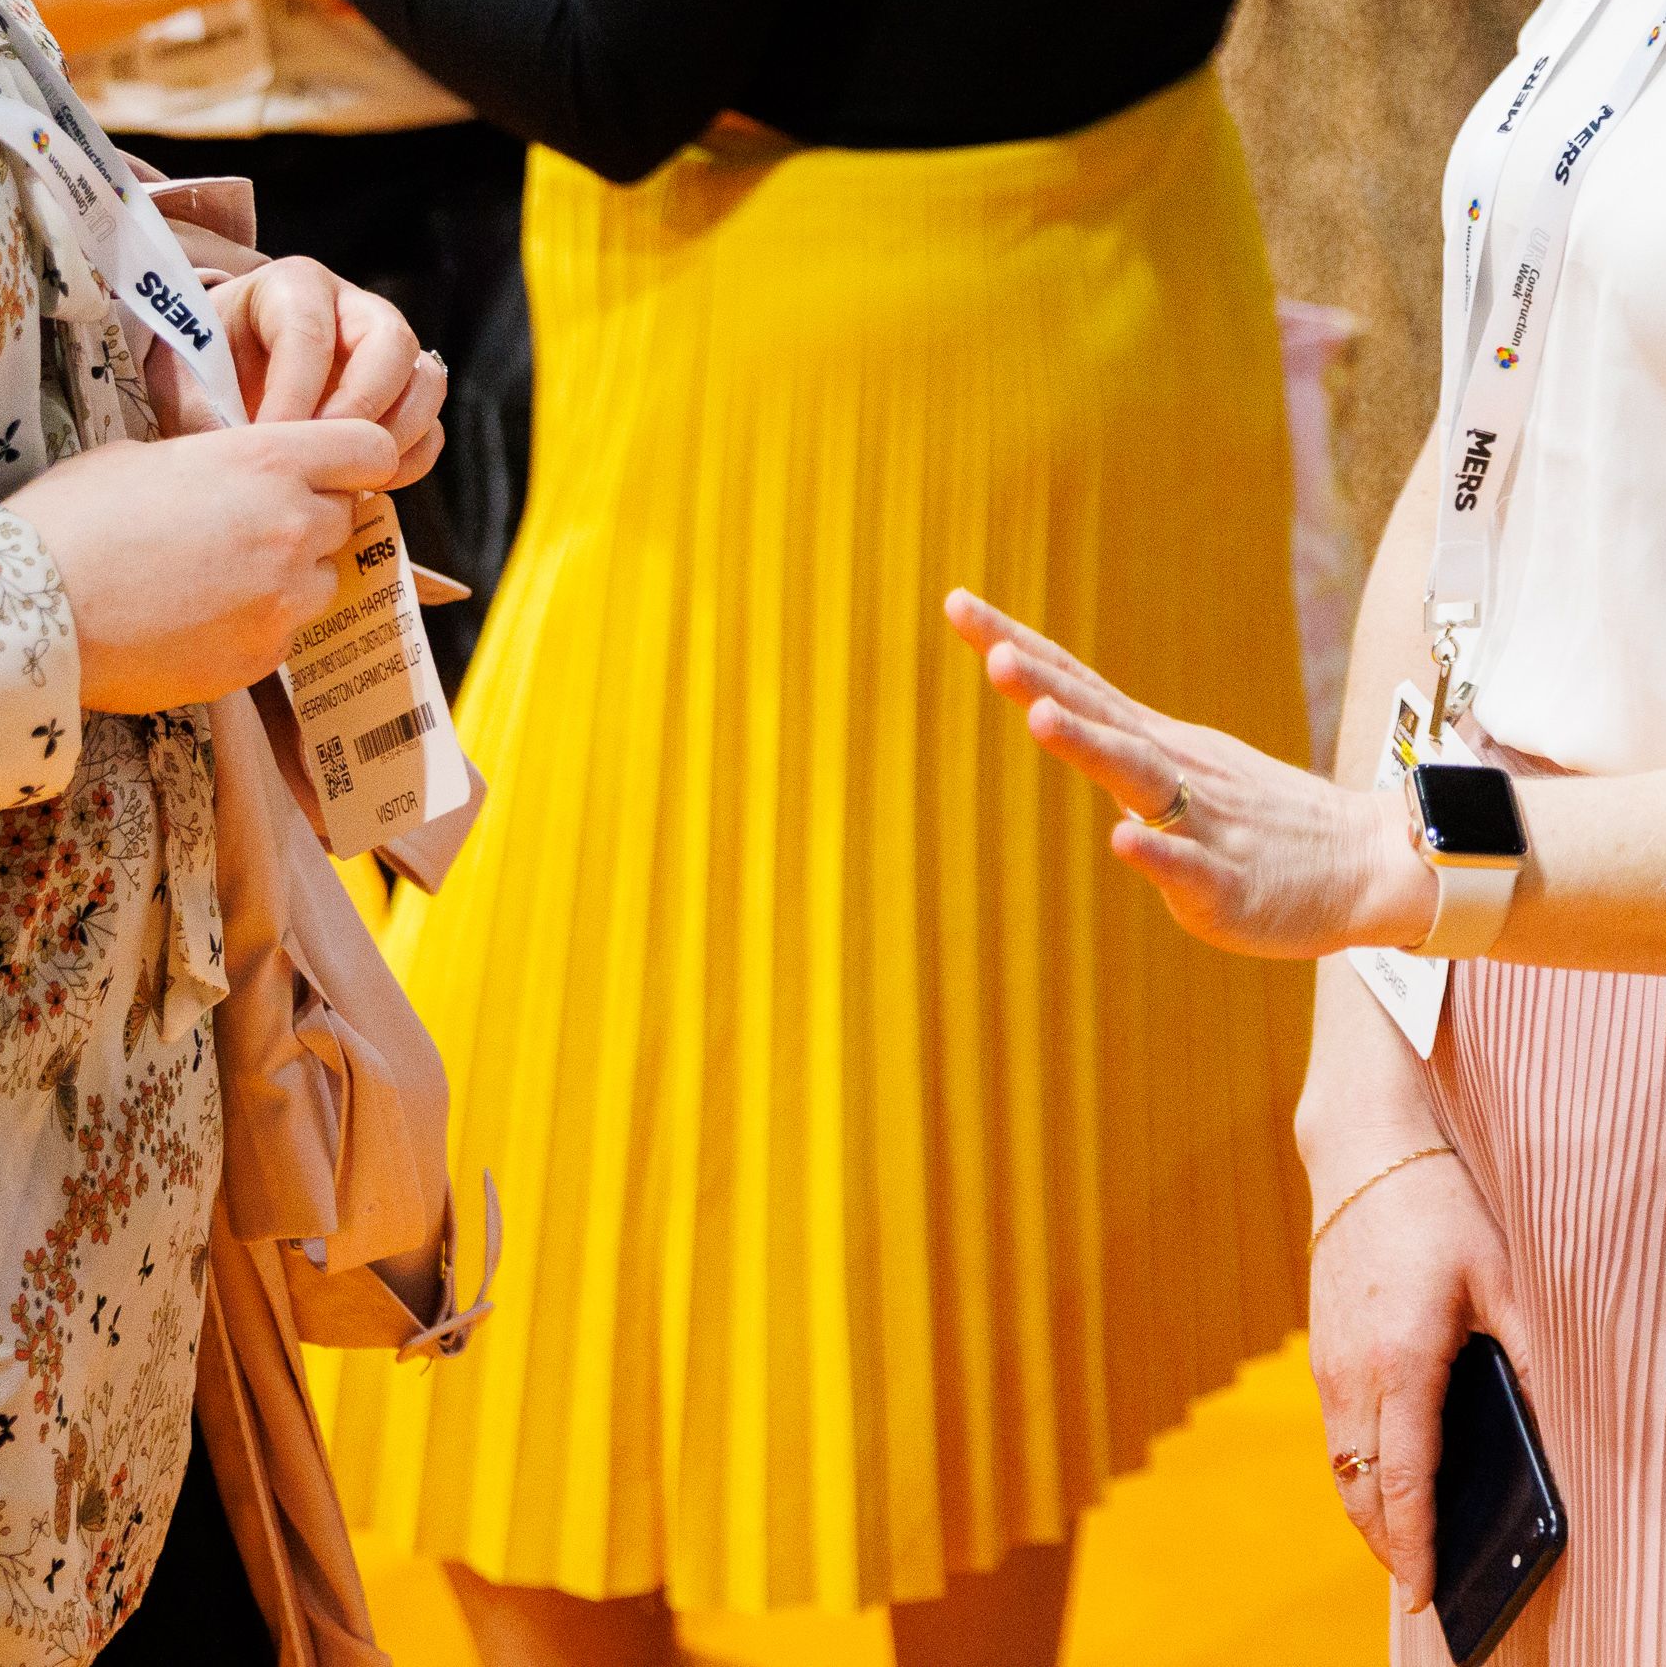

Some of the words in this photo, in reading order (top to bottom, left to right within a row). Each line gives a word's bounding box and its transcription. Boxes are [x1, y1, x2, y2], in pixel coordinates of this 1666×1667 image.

[1498, 55, 1549, 134] MERS
[60, 105, 113, 184] Construction
[1554, 103, 1615, 187] MERS
[49, 152, 90, 217] Construction
[77, 174, 99, 208] Week
[136, 271, 213, 353] MERS
[1511, 267, 1541, 348] Construction
[1512, 262, 1531, 299] Week
[1454, 428, 1498, 513] MERS
[355, 536, 397, 577] MERS
[302, 605, 361, 651] ALEXANDRA
[359, 579, 407, 620] HARPER
[287, 666, 309, 692] SENIOR
[299, 681, 357, 723] HERRINGTON
[353, 656, 408, 694] CARMICHAEL
[407, 642, 423, 667] LLP
[375, 791, 419, 825] VISITOR
[1375, 952, 1408, 1003] SPEAKER
